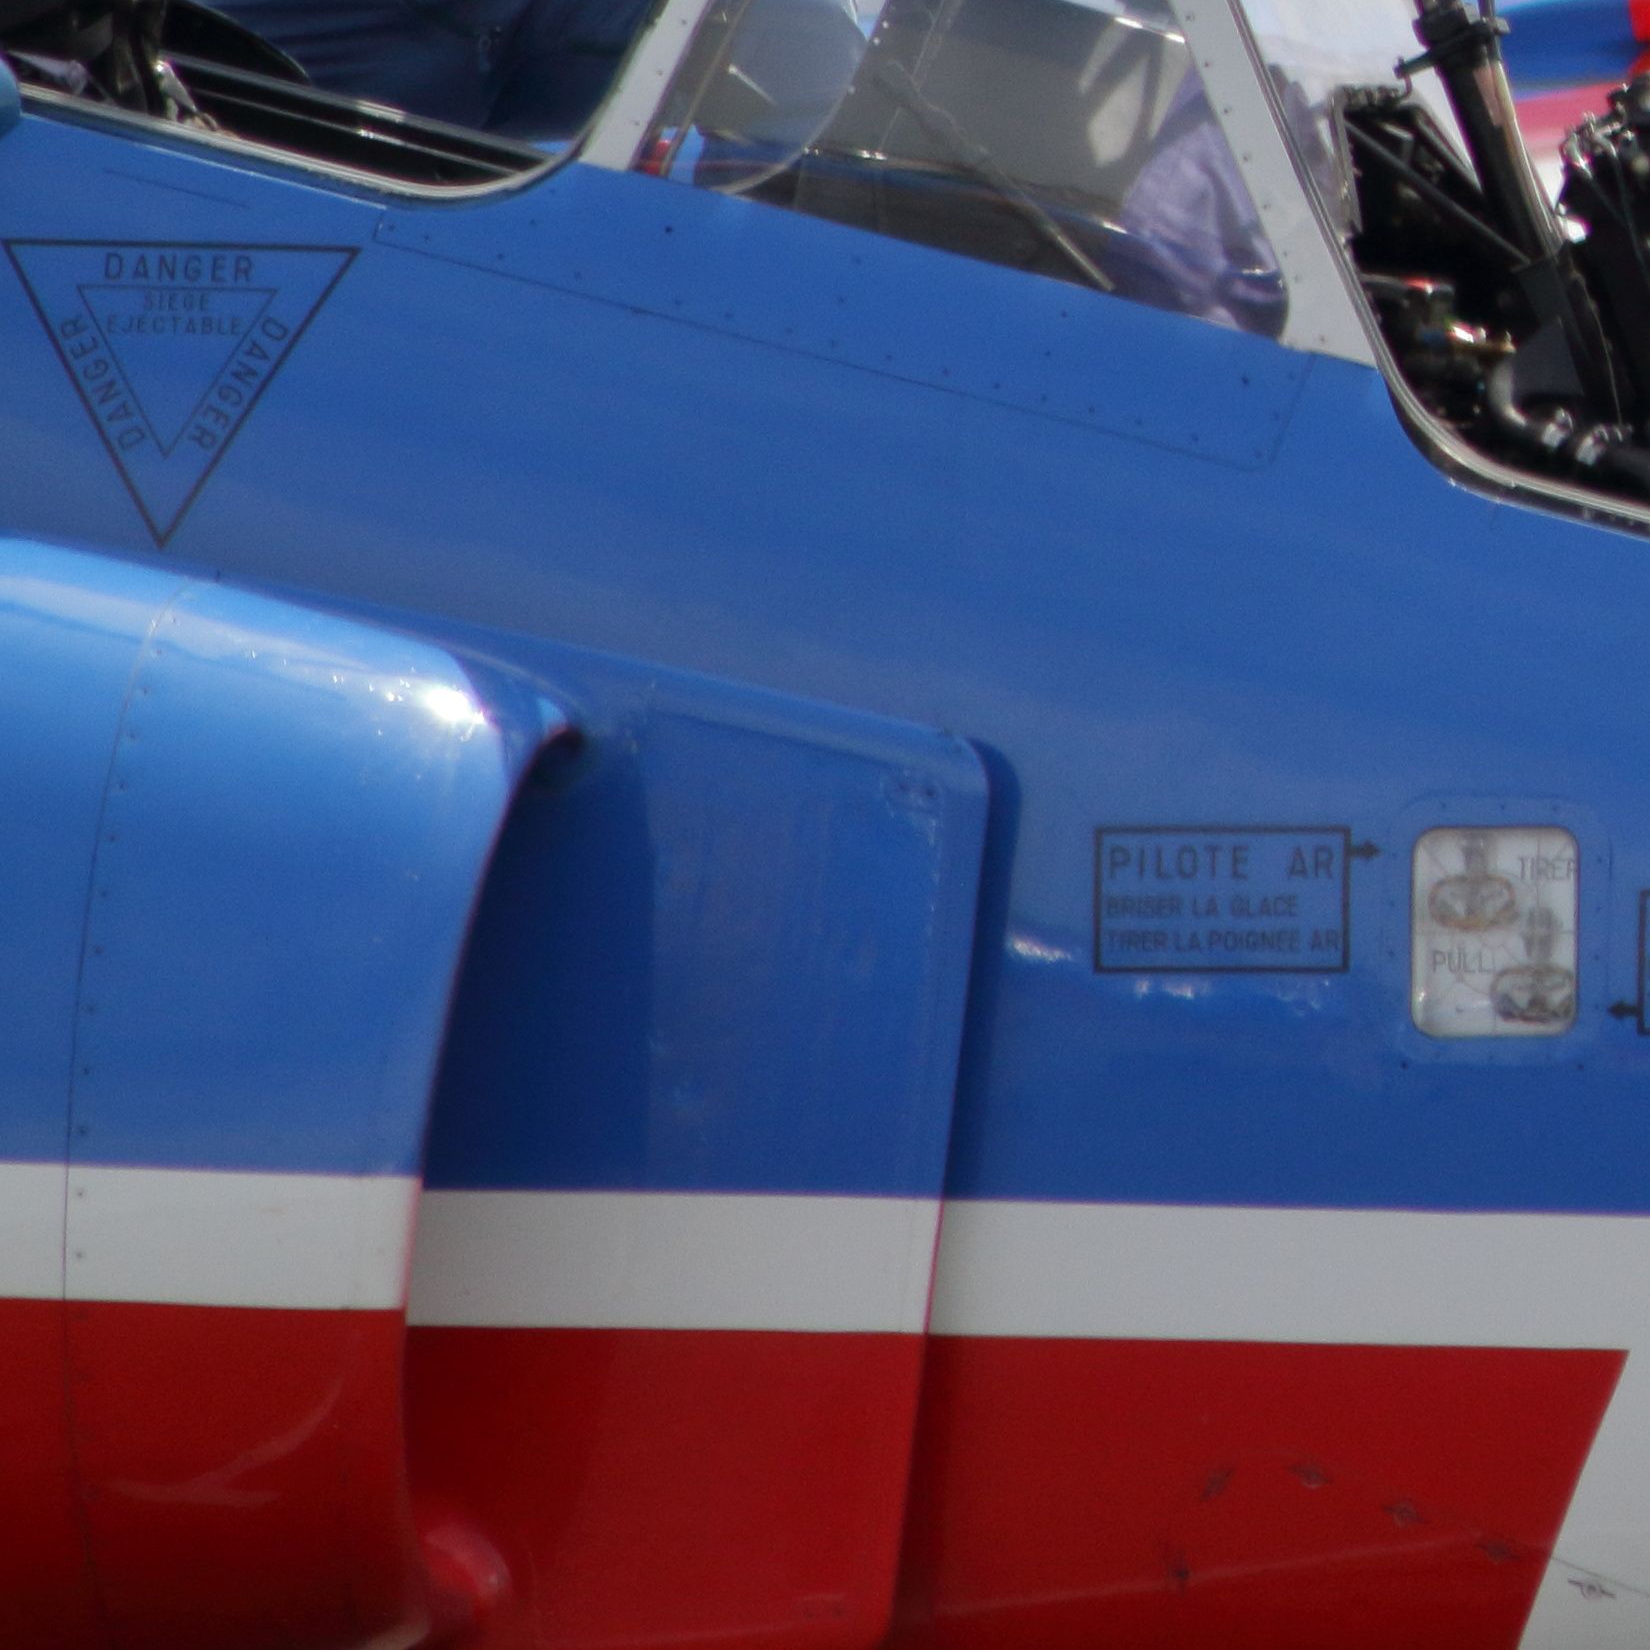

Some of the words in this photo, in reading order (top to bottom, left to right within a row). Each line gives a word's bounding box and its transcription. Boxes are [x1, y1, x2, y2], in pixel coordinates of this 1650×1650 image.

[103, 252, 254, 283] DANGER
[107, 314, 242, 336] EJECTABLE
[60, 312, 146, 451] DANGER
[189, 316, 290, 451] DANGER
[1108, 845, 1249, 880] PILOTE
[1287, 845, 1335, 880] AR
[1106, 895, 1181, 918] BRISER
[1191, 896, 1219, 918] LA
[1231, 896, 1298, 918] GLACE
[1107, 929, 1169, 952] TIRER
[1175, 929, 1201, 952] LA
[1209, 929, 1300, 952] POIGNEE
[1310, 929, 1342, 952] AR
